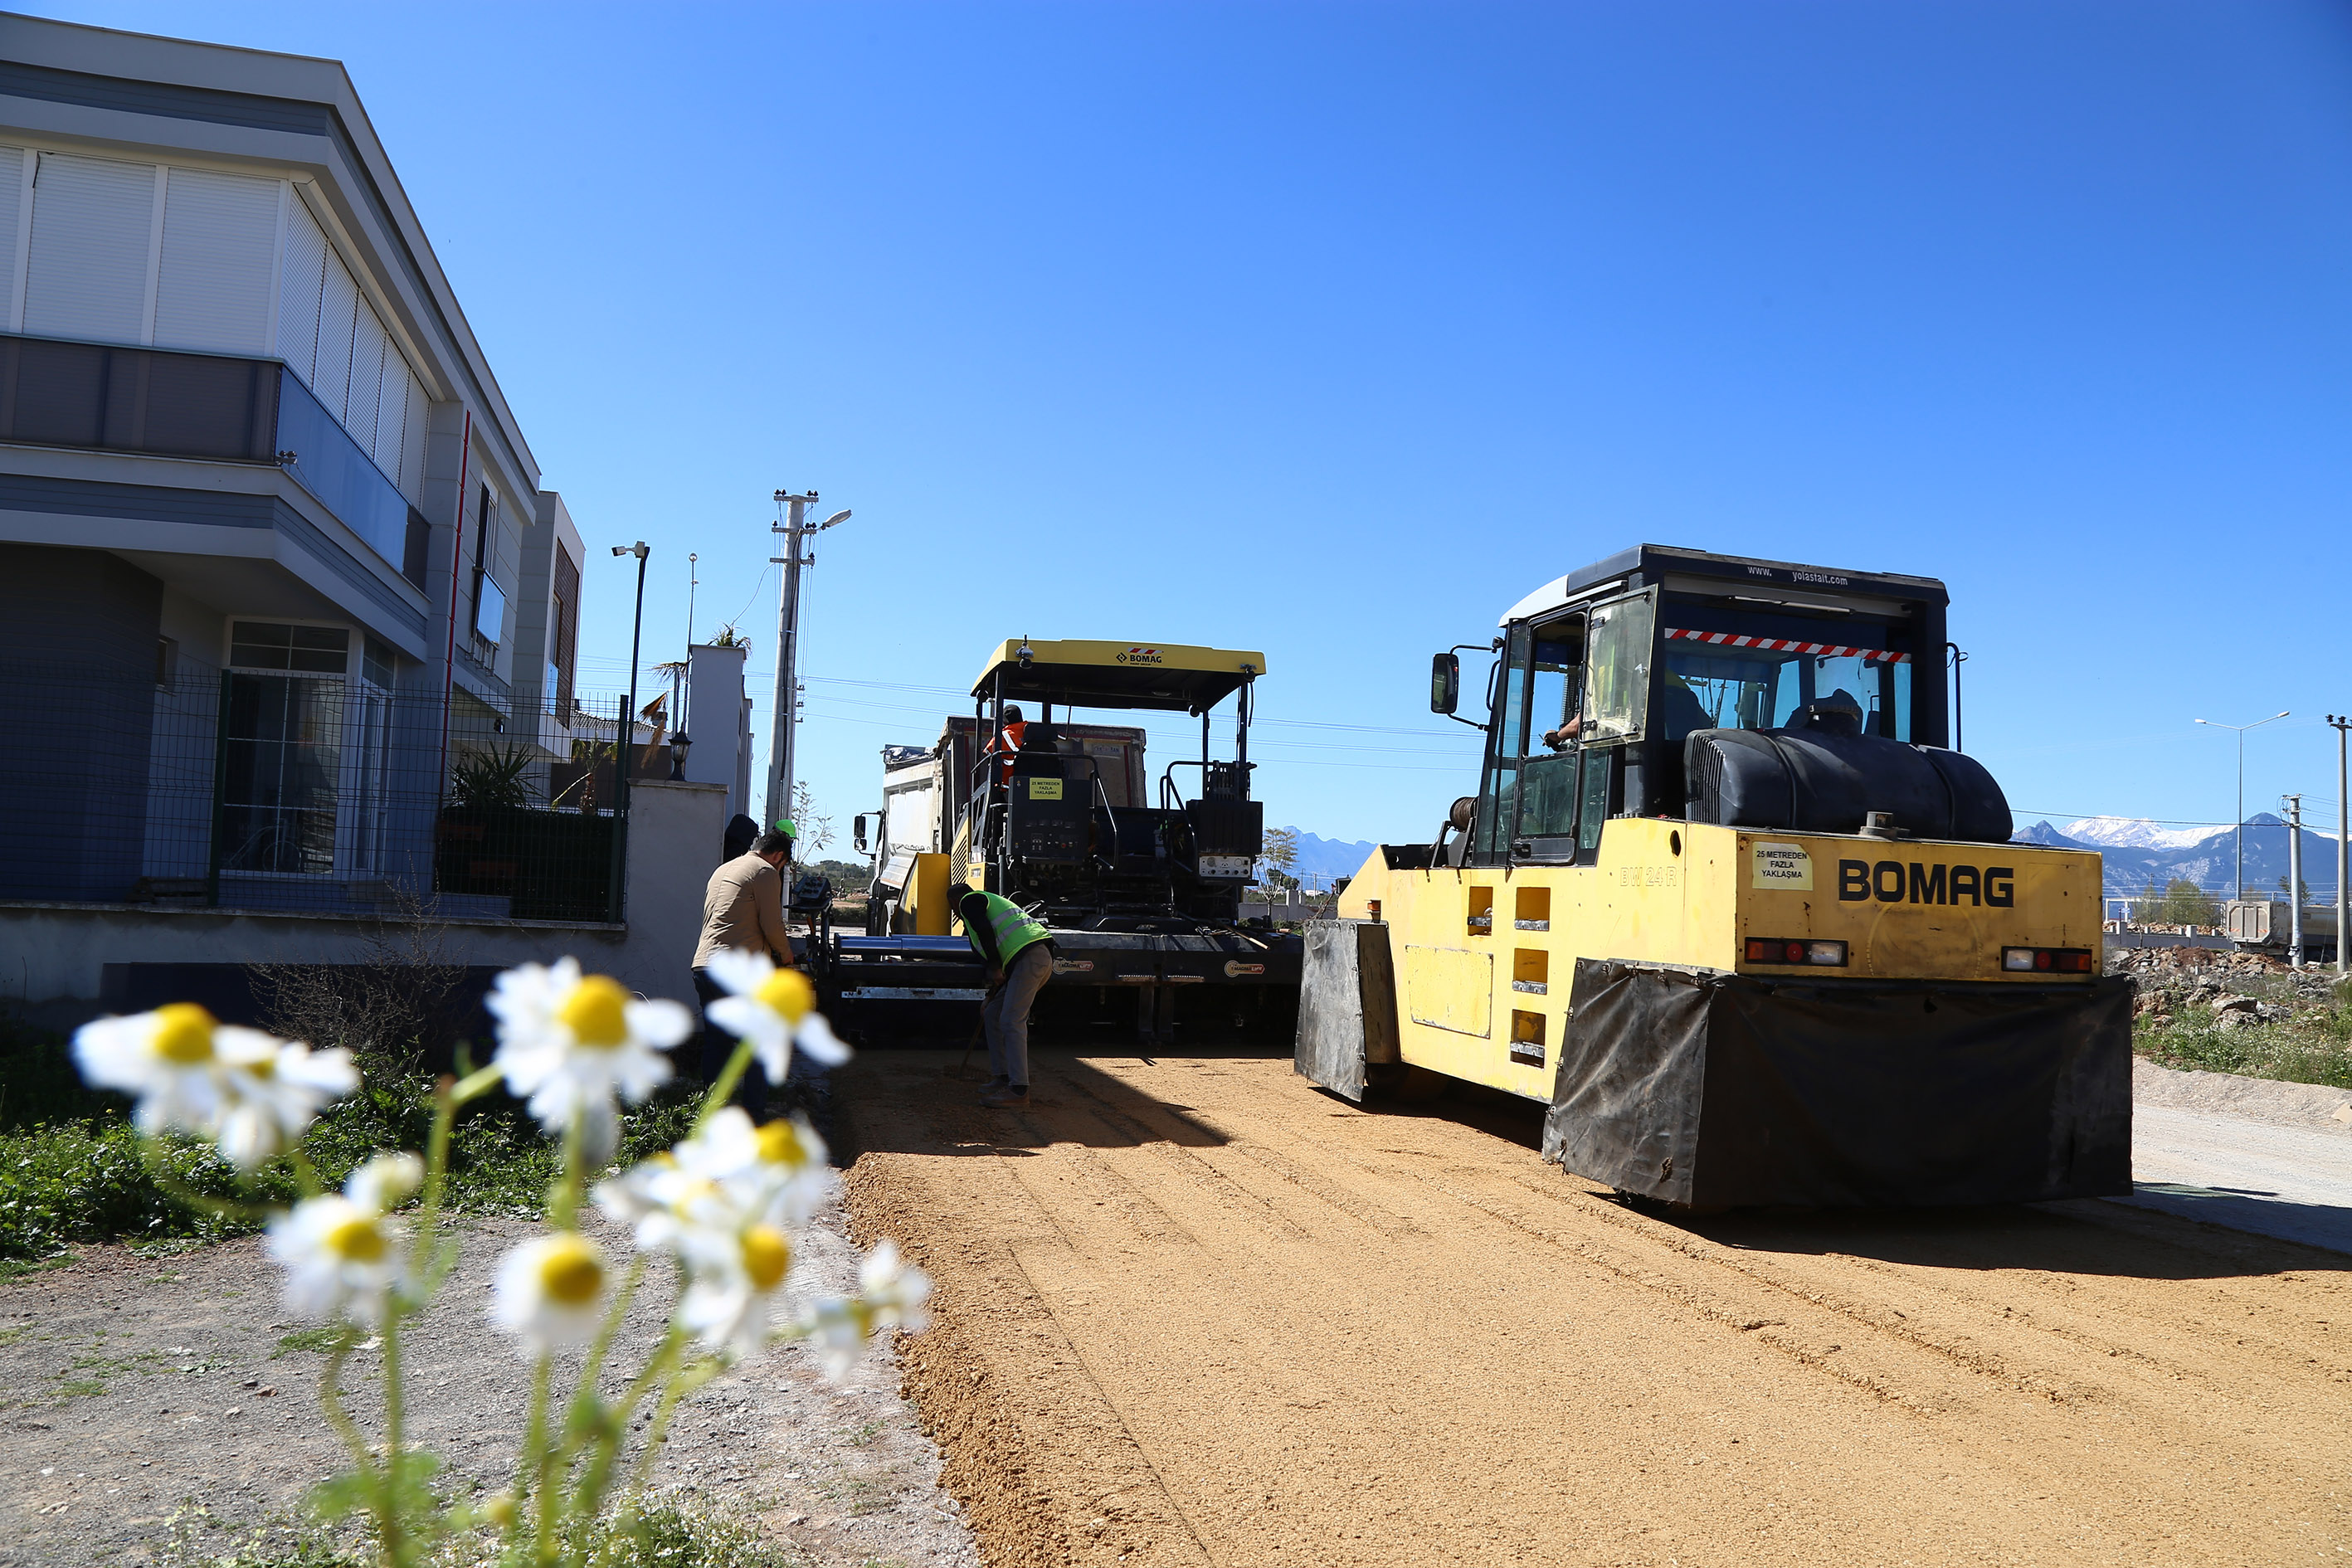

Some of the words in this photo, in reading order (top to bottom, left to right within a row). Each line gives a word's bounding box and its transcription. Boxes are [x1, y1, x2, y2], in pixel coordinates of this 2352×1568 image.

[1747, 566, 1772, 577] www.
[1129, 655, 1162, 664] BOMAG
[1766, 850, 1808, 859] METREDEN
[1770, 860, 1794, 869] FAZLA
[1619, 866, 1643, 887] BW
[1761, 869, 1803, 879] YAKLAŞMA
[1838, 859, 2014, 908] BOMAG
